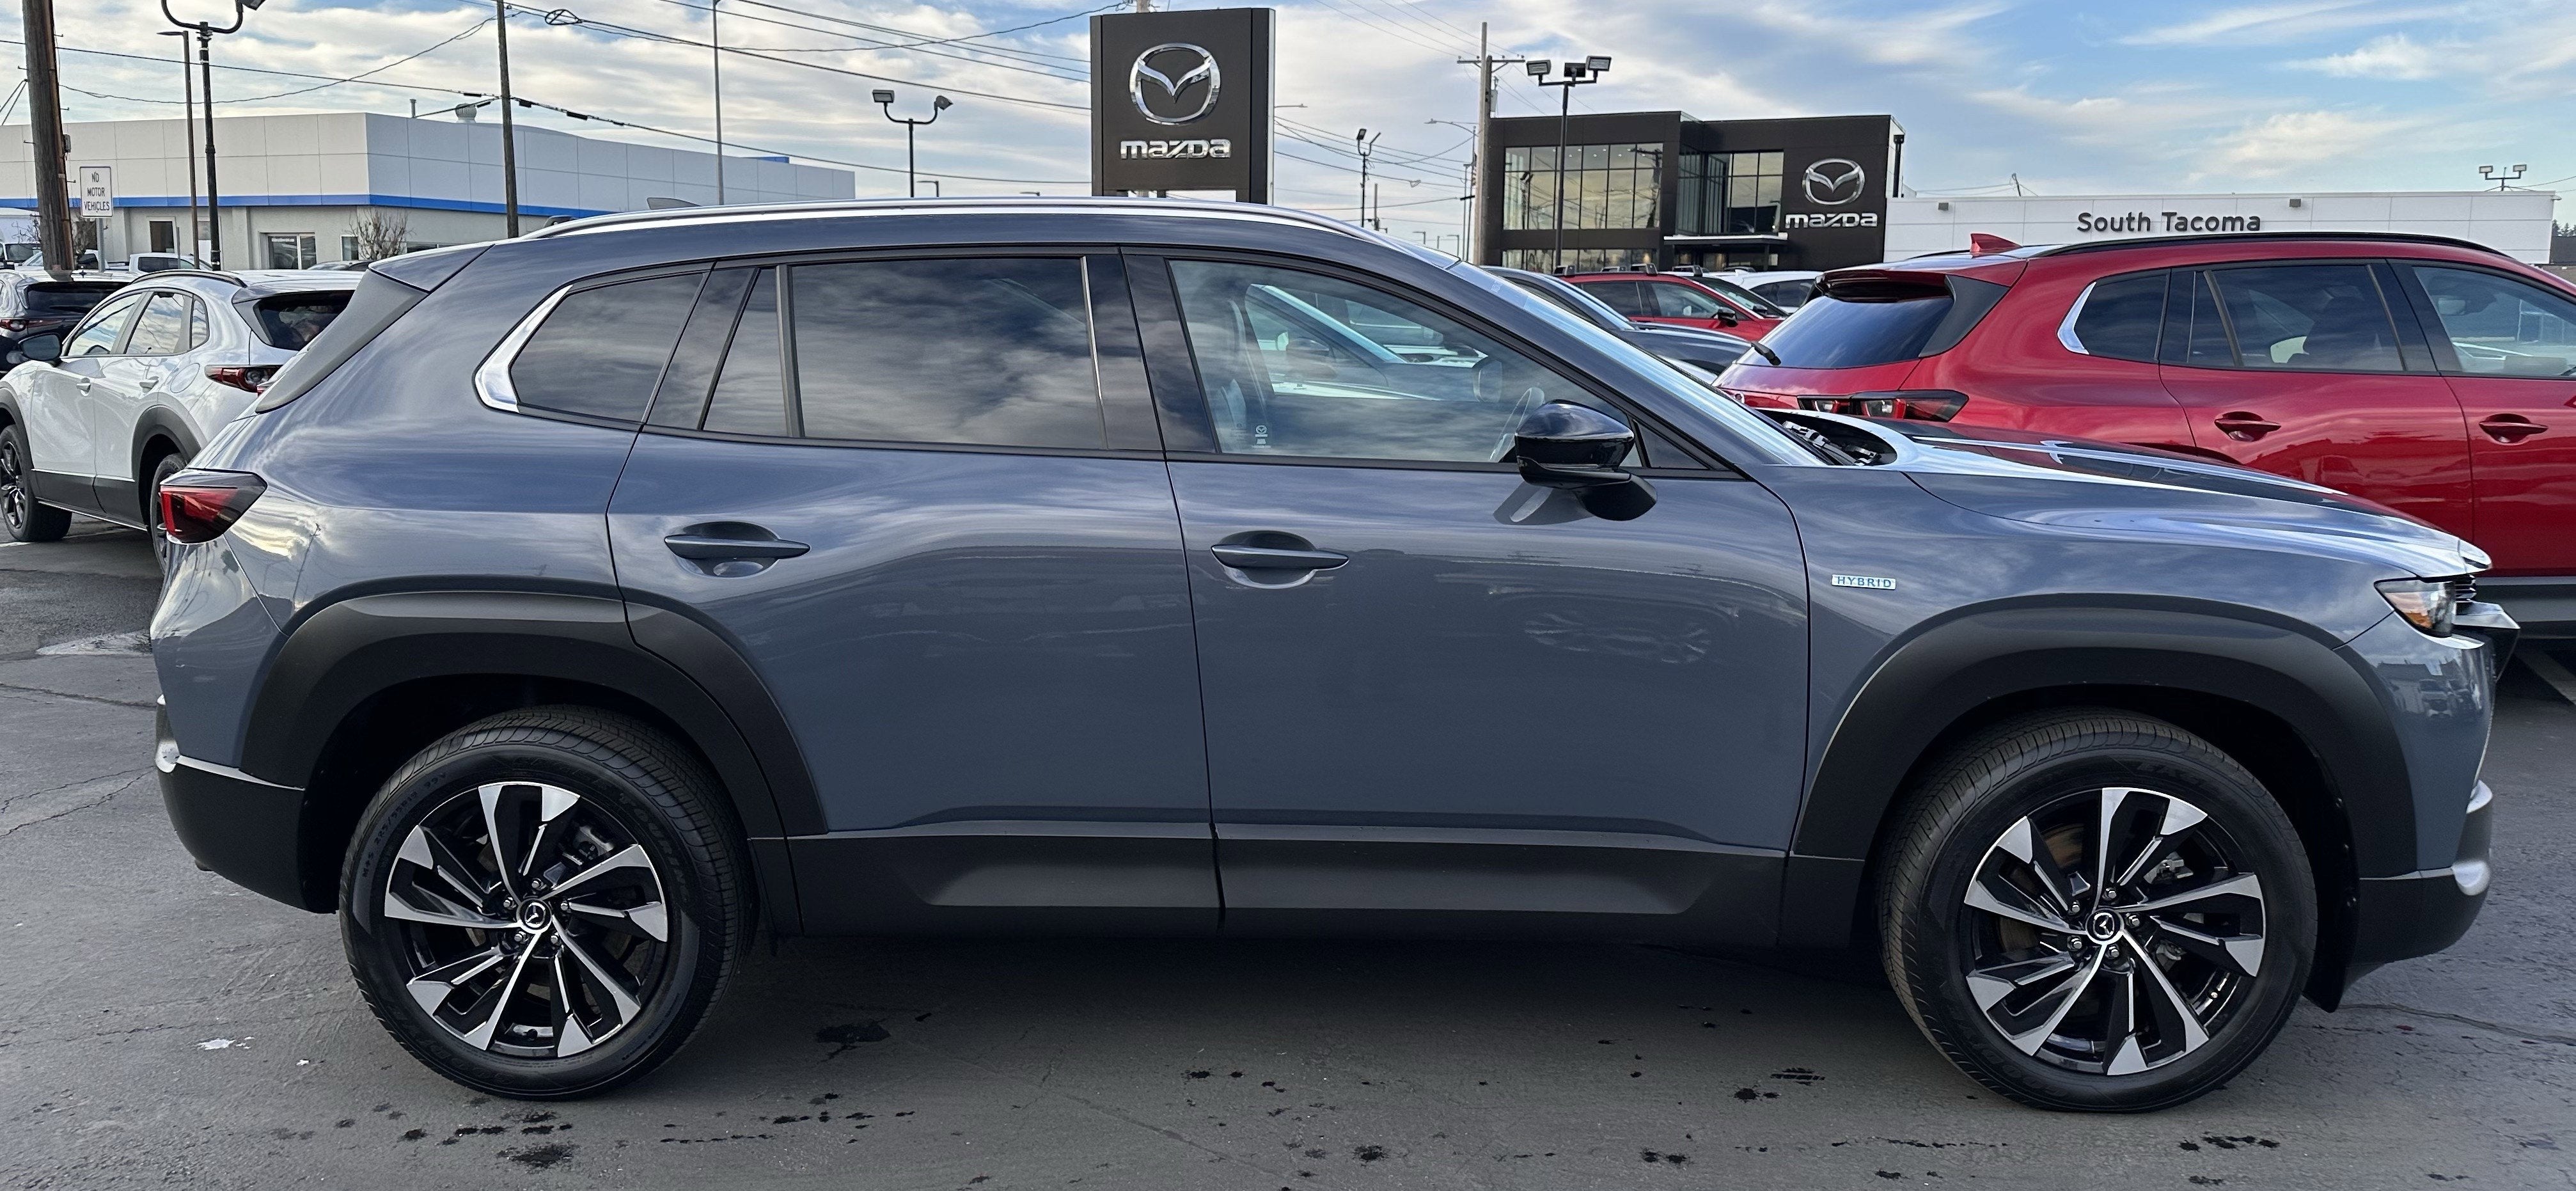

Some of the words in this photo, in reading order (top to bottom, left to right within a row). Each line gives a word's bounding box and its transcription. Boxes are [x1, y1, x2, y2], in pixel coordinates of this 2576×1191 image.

[91, 171, 100, 183] NO
[87, 187, 105, 197] MOTOR
[84, 201, 110, 211] VEHICLES
[2077, 212, 2151, 232] South
[2161, 212, 2261, 232] Tacoma
[1837, 576, 1892, 588] HYBRID
